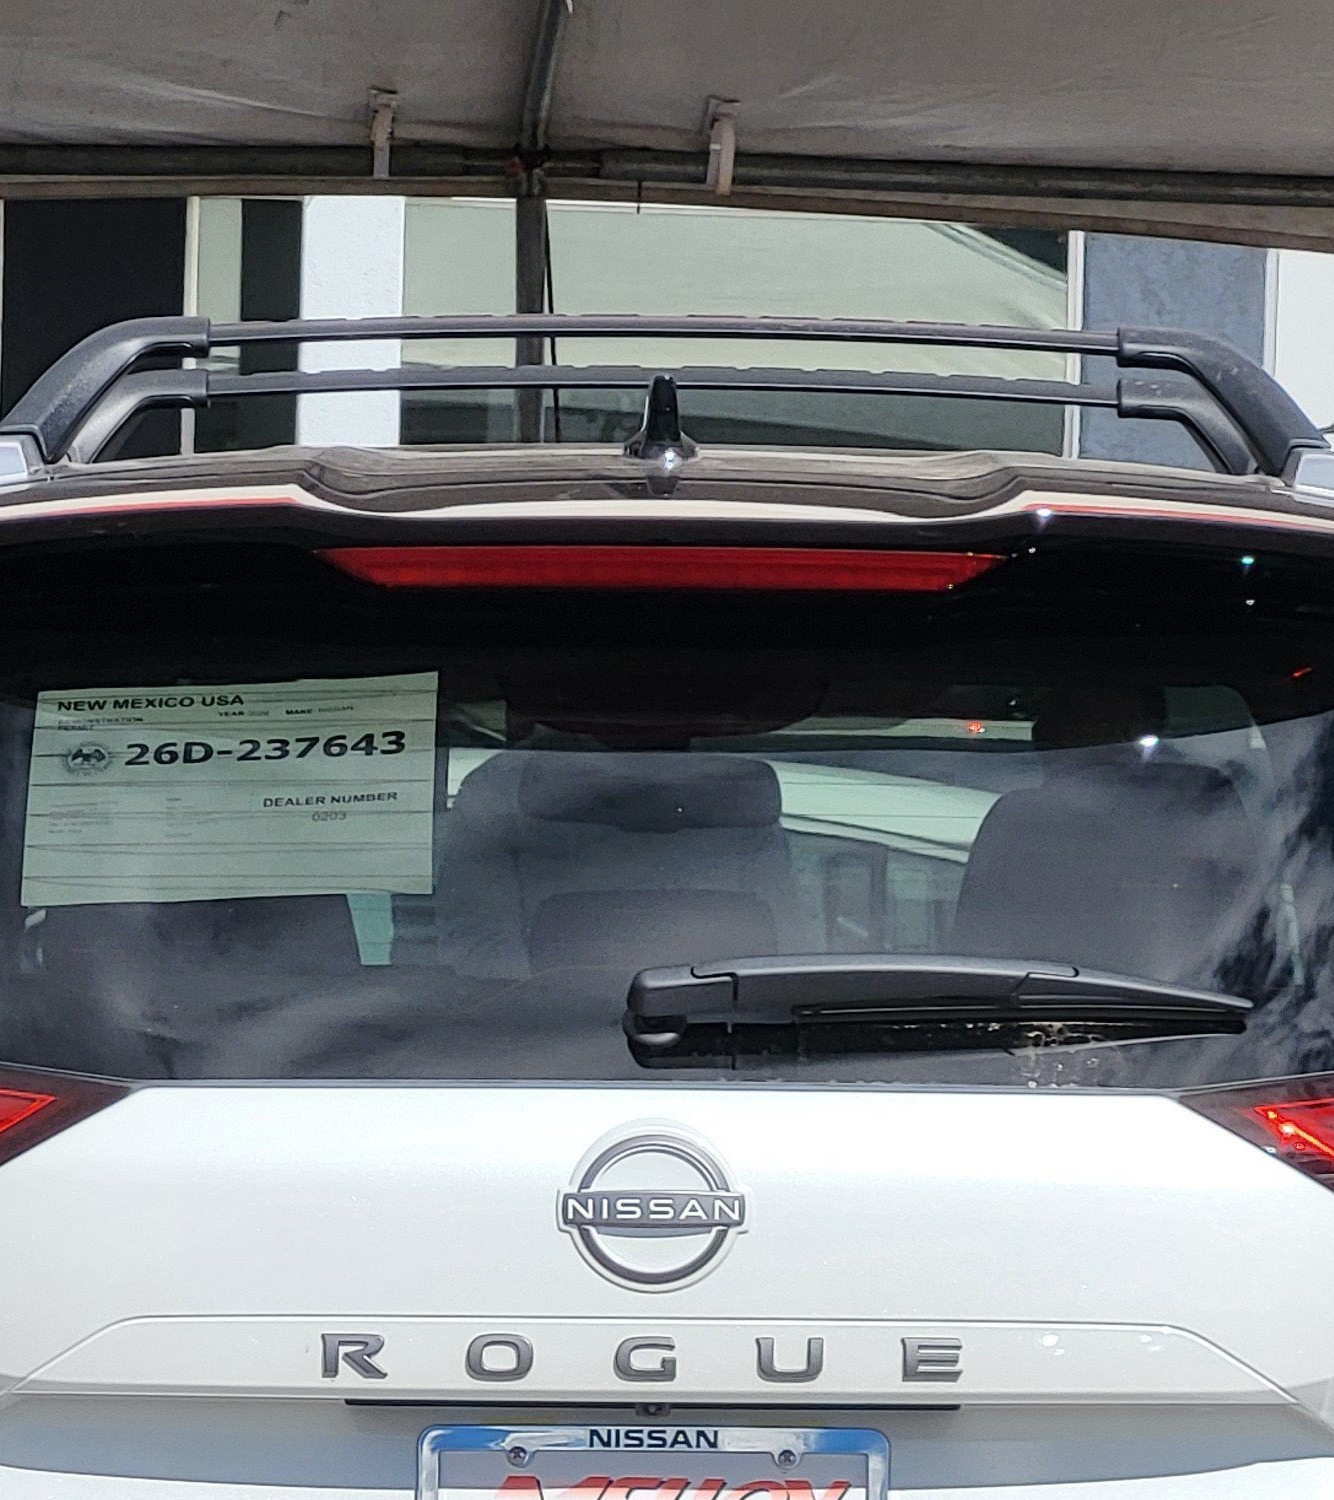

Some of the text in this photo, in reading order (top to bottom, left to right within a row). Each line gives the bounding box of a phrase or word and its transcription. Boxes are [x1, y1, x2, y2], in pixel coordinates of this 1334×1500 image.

[58, 694, 244, 711] NEW MEXICO USA
[124, 730, 407, 766] 26D-237643
[263, 792, 398, 808] DEALER NUMBER
[568, 1198, 742, 1222] NISSAN
[321, 1333, 963, 1383] ROGUE
[588, 1428, 719, 1449] NISSAN
